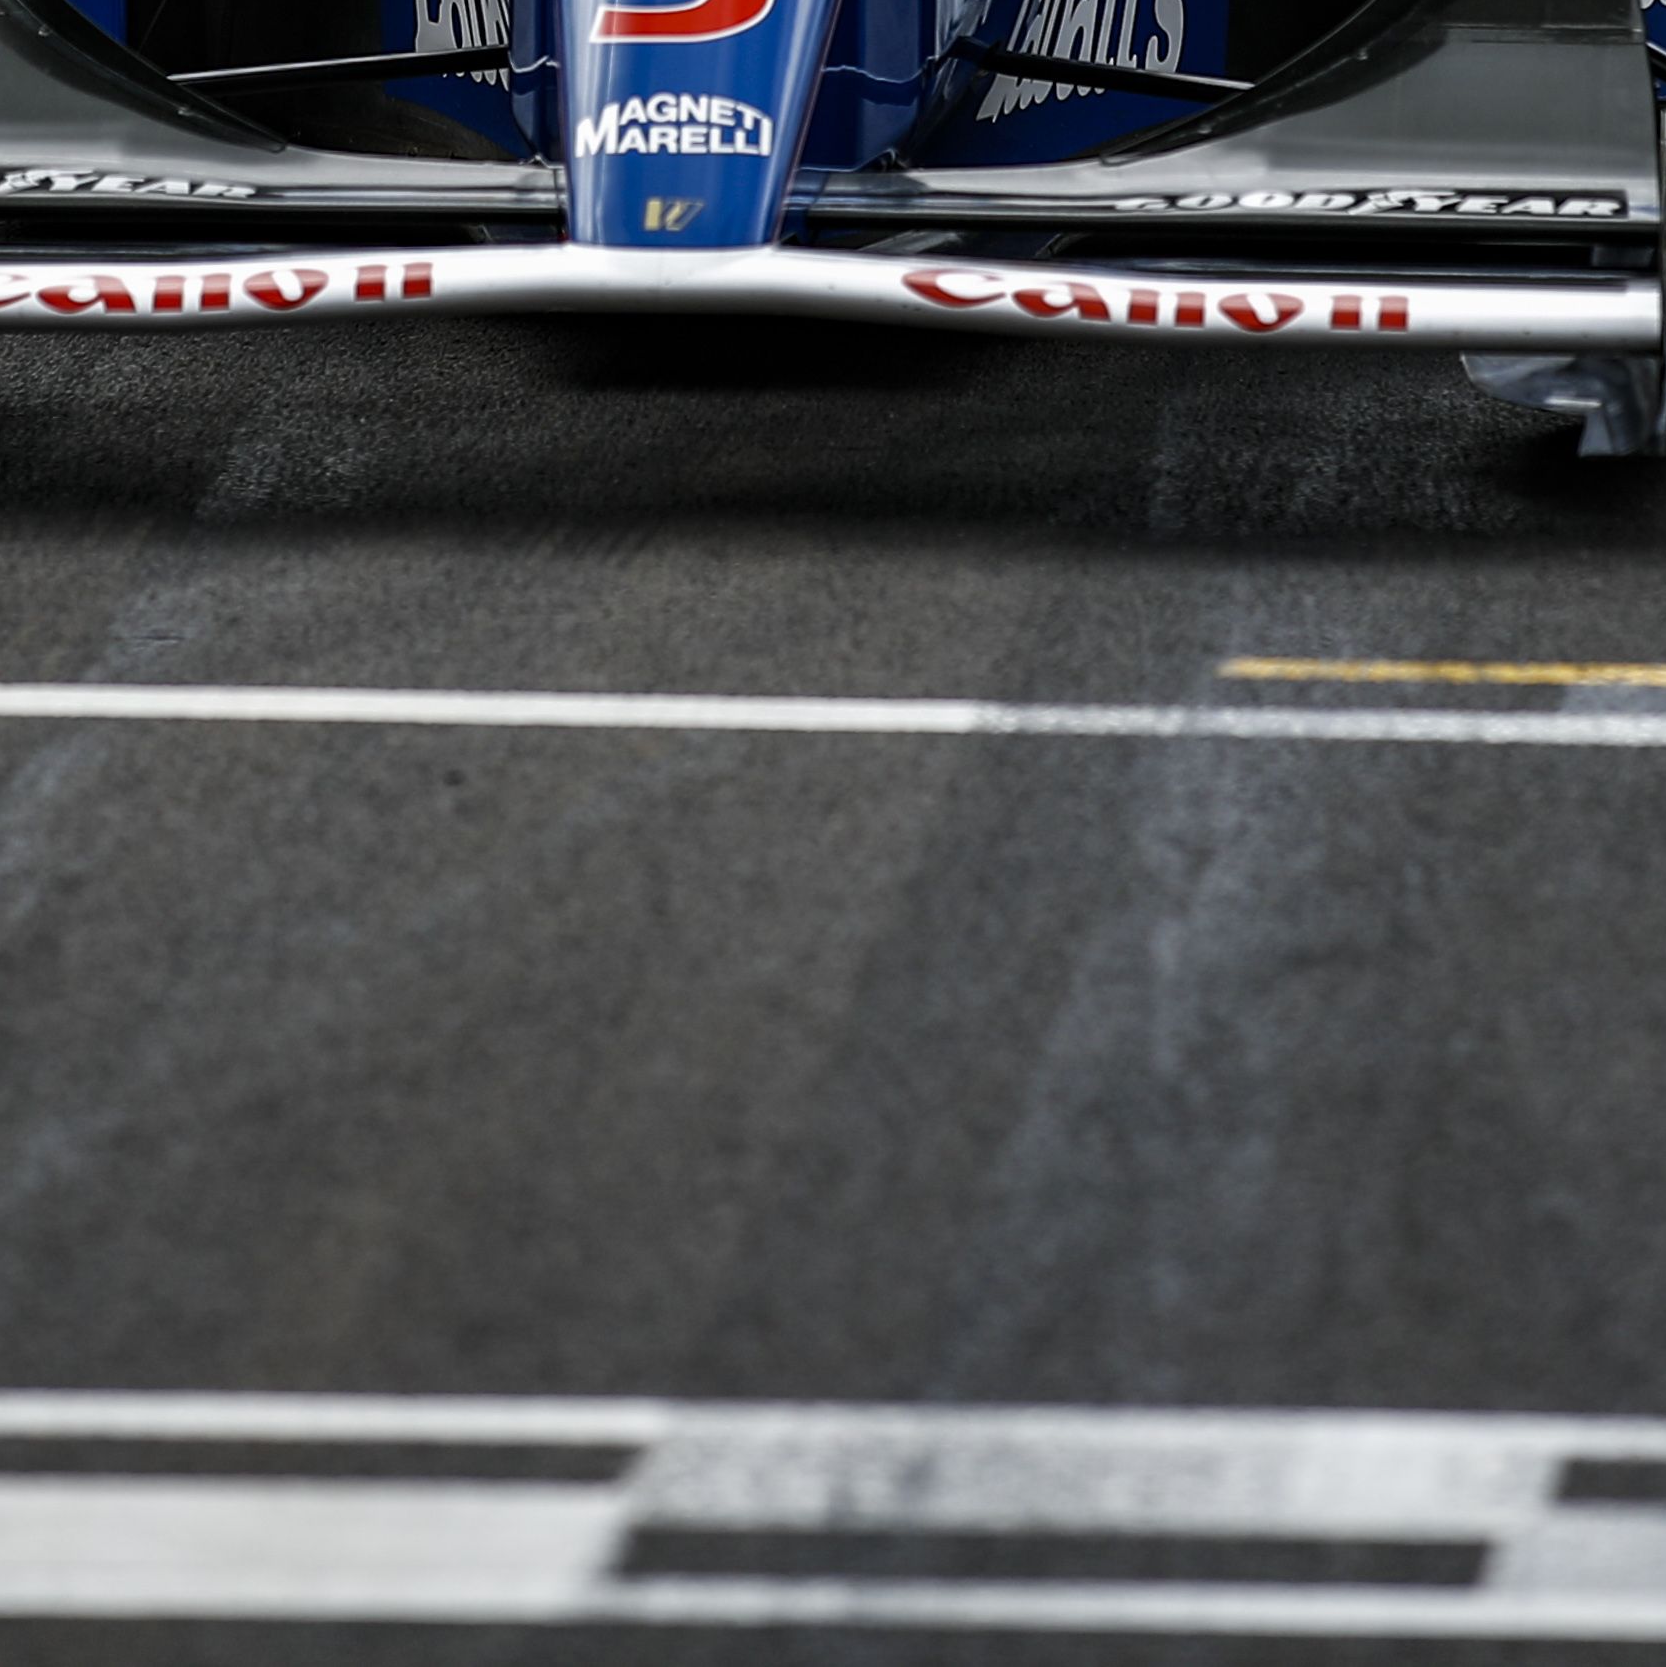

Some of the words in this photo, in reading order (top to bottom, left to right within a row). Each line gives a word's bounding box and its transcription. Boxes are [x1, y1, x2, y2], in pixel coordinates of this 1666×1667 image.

[574, 91, 773, 138] MAGNETI
[574, 120, 773, 158] MARELLI
[901, 267, 1411, 334] Canon
